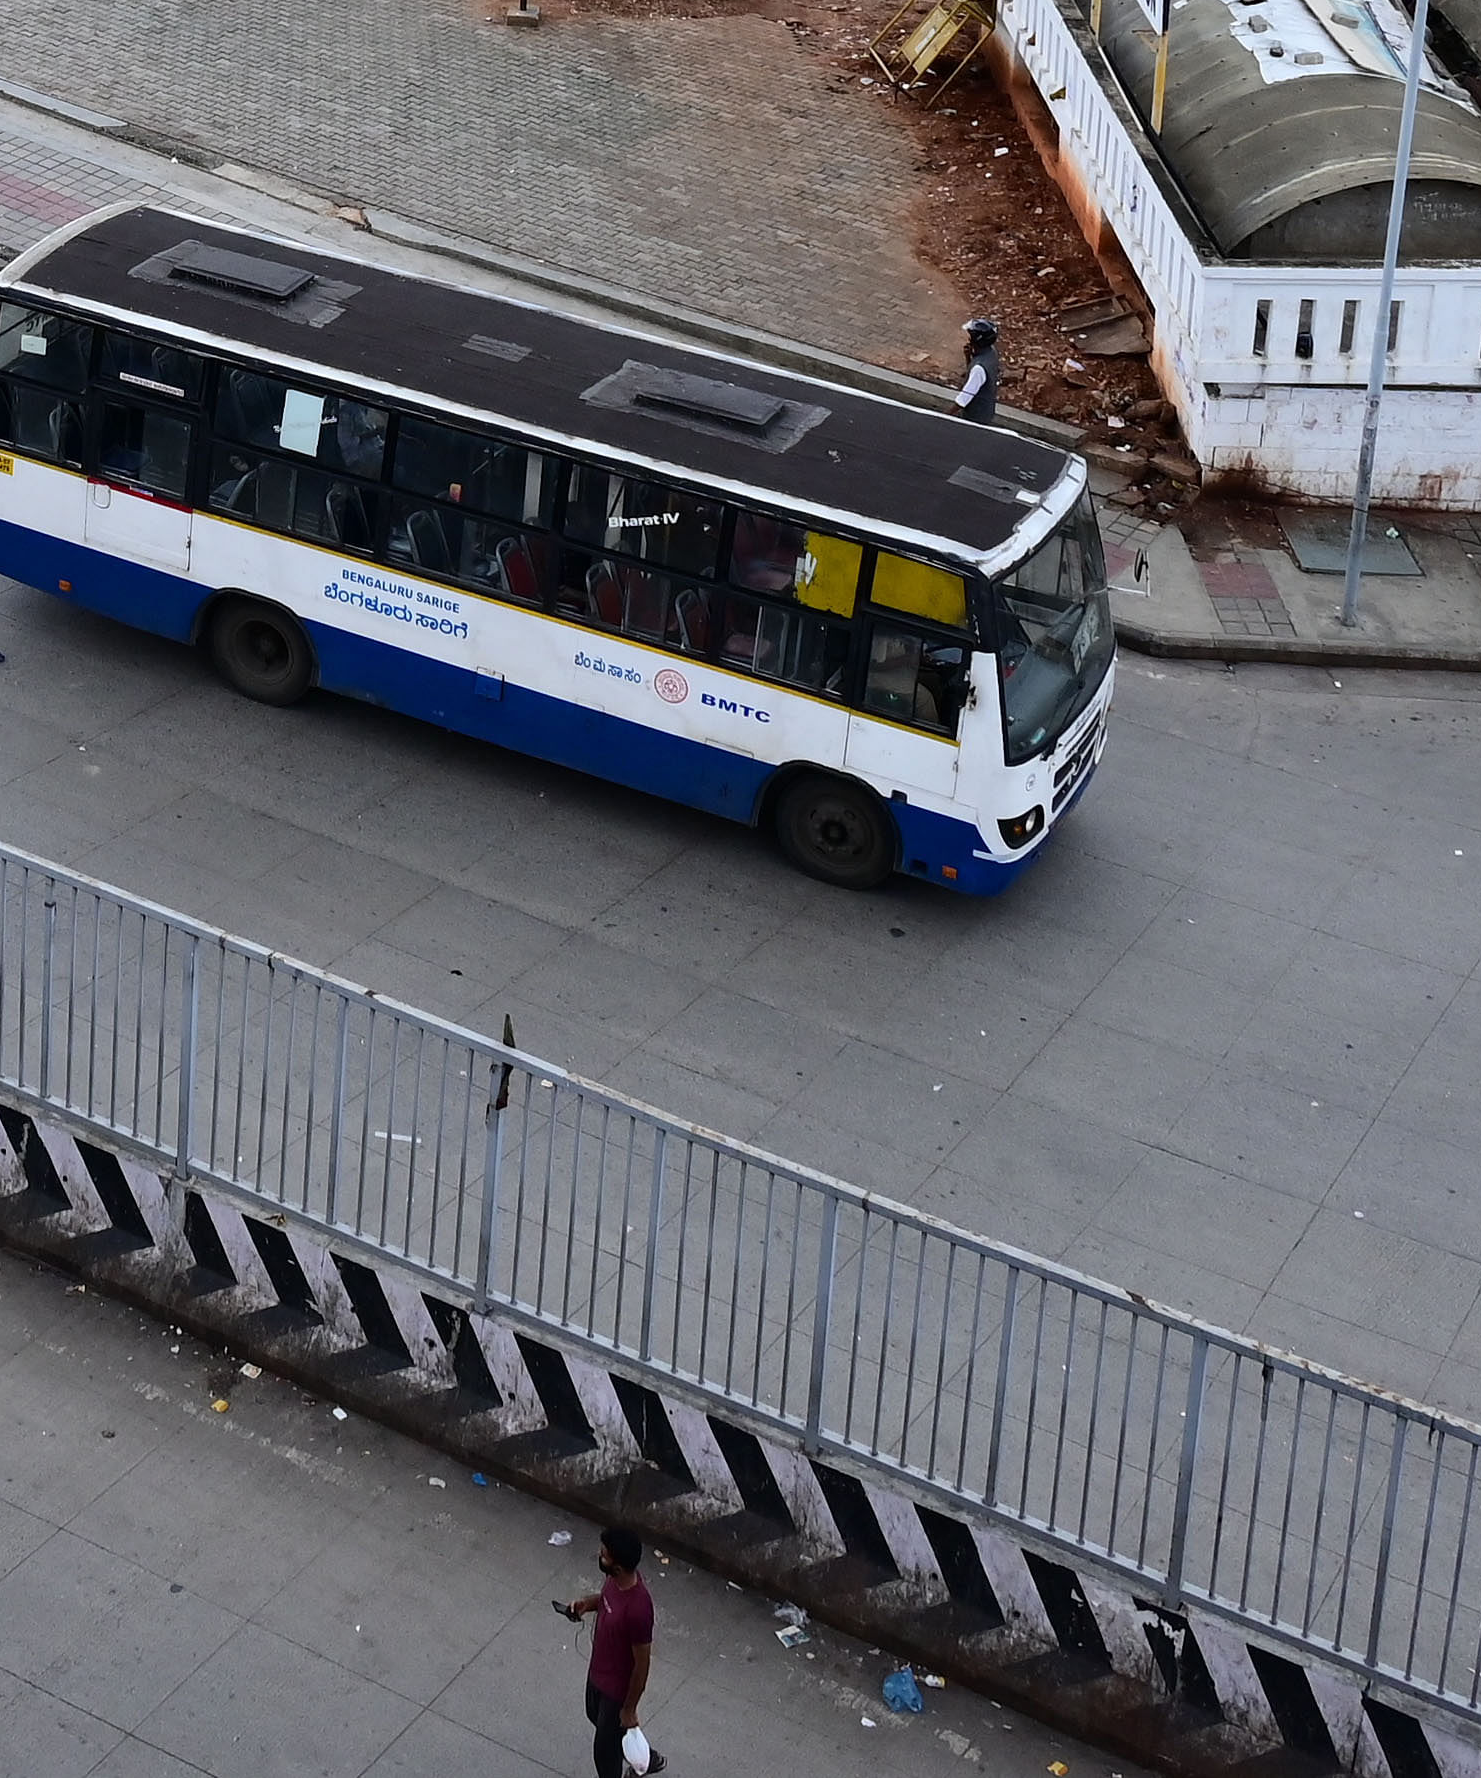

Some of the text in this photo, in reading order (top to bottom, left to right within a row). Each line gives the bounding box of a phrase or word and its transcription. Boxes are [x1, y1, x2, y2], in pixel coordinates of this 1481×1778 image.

[323, 582, 470, 640] ಬೆಂಗಳೂರು ಸಾರಿಗೆ
[341, 568, 461, 614] BENGALURU SARIGE
[700, 692, 771, 724] BMTC
